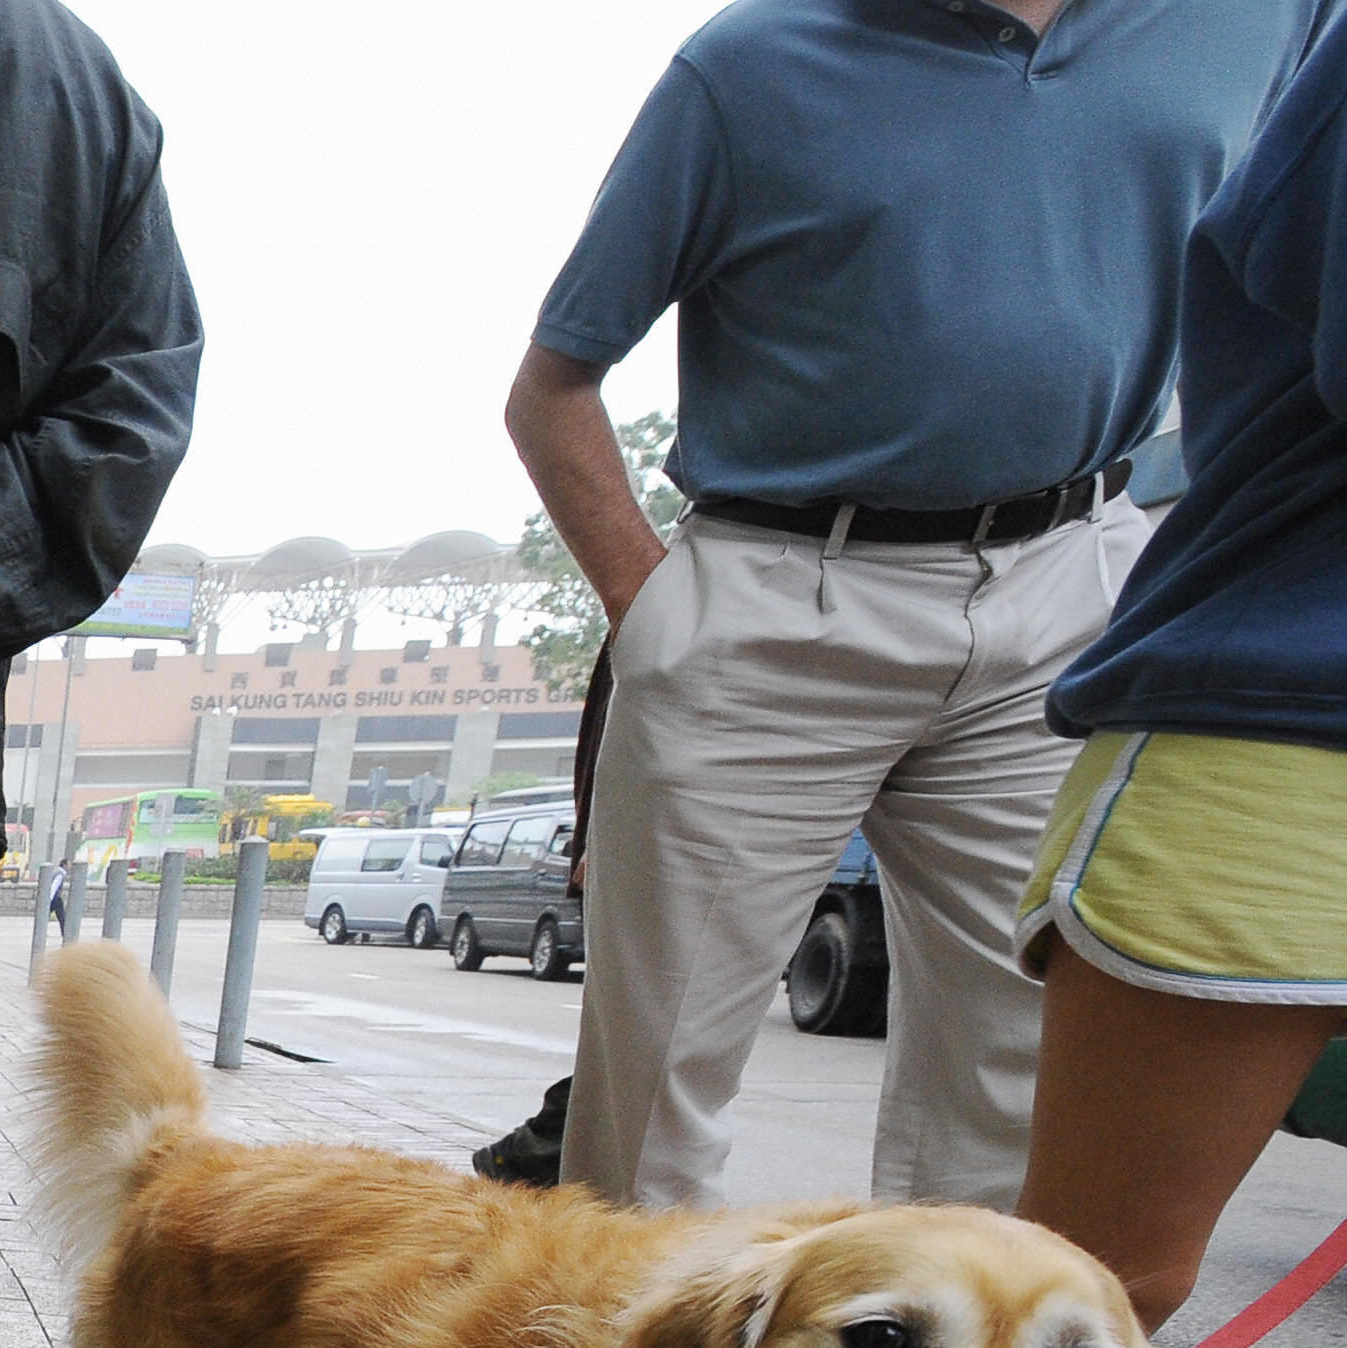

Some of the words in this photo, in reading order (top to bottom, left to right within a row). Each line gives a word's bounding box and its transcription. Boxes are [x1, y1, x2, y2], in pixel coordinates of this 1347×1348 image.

[189, 692, 223, 712] SAI
[229, 692, 287, 711] KUNG
[291, 691, 348, 710] TANG
[353, 690, 404, 709] SHIU
[410, 688, 447, 707] KIN
[451, 687, 541, 707] SPORTS
